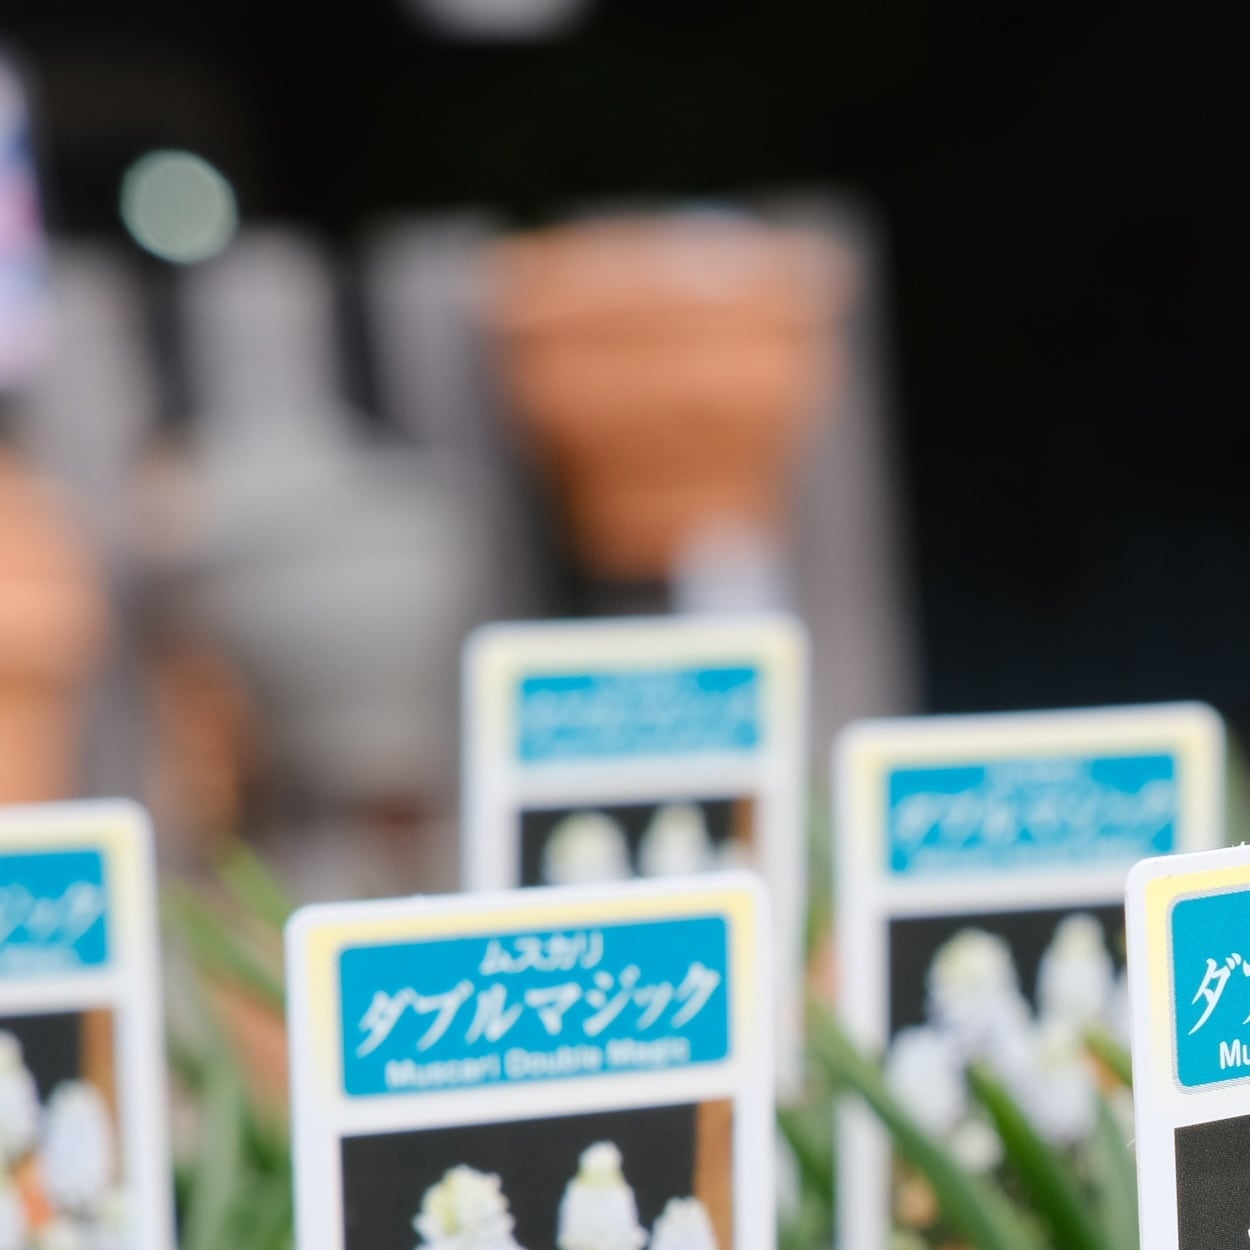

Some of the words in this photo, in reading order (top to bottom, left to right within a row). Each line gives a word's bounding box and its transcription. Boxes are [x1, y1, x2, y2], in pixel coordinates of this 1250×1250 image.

[479, 930, 604, 976] ムスカリ
[355, 961, 722, 1058] ダブルマジック
